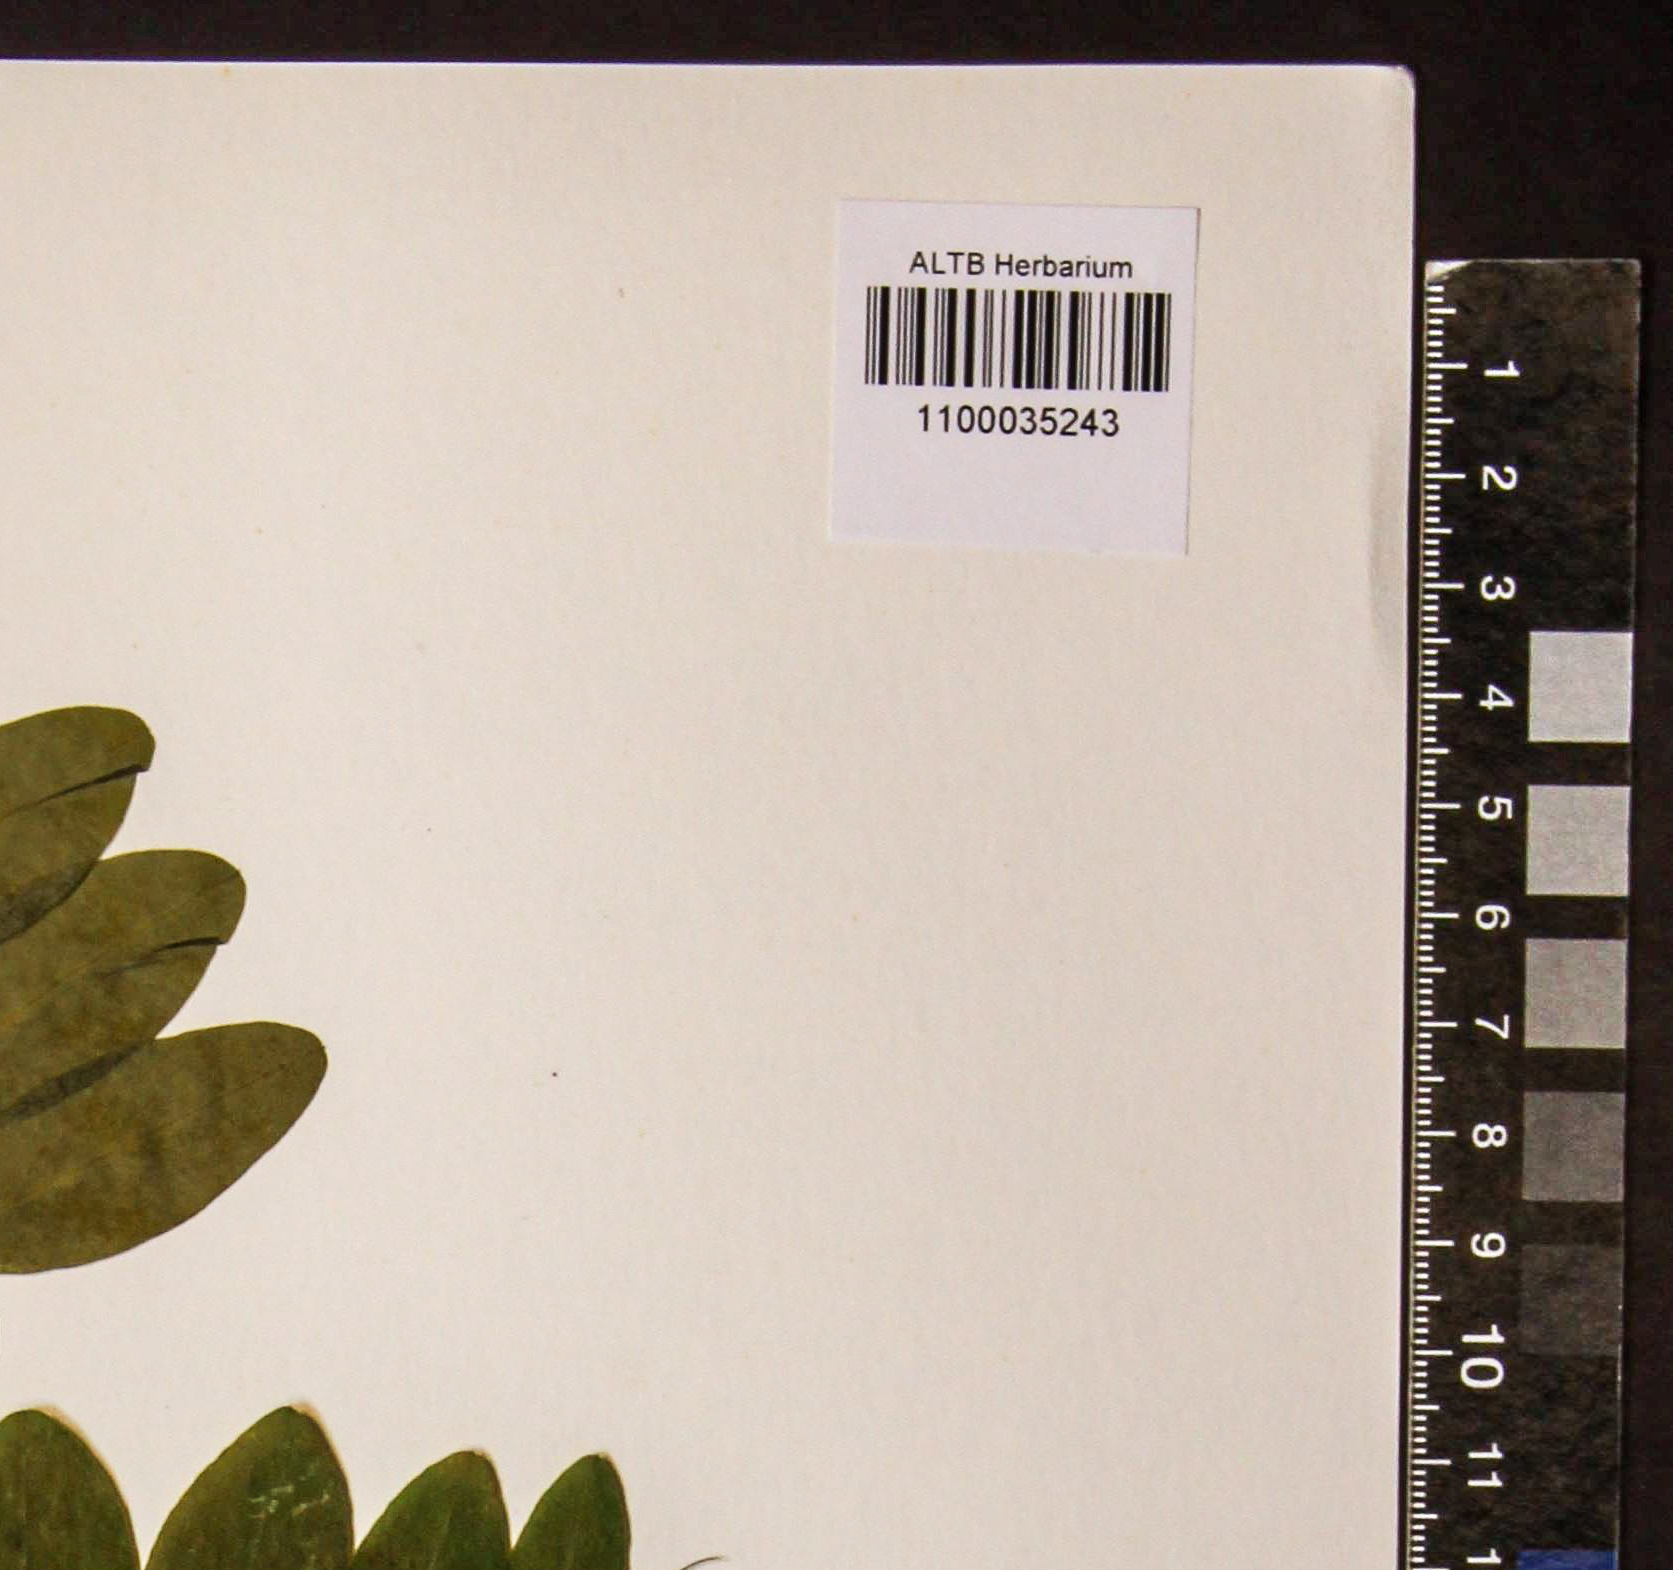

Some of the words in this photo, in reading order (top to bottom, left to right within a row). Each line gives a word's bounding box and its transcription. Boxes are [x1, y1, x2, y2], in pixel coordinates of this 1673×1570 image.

[909, 250, 985, 277] ALTB
[994, 252, 1134, 280] Herbarium
[1484, 360, 1521, 377] 1
[917, 403, 1121, 438] 1100035243
[1482, 465, 1518, 491] 2
[1480, 575, 1516, 601] 3
[1479, 684, 1515, 711] 4
[1477, 795, 1513, 821] 5
[1475, 904, 1511, 930] 6
[1474, 1014, 1510, 1040] 7
[1471, 1123, 1508, 1149] 8
[1470, 1231, 1507, 1258] 9
[1460, 1323, 1506, 1389] 10
[1467, 1442, 1503, 1487] 11
